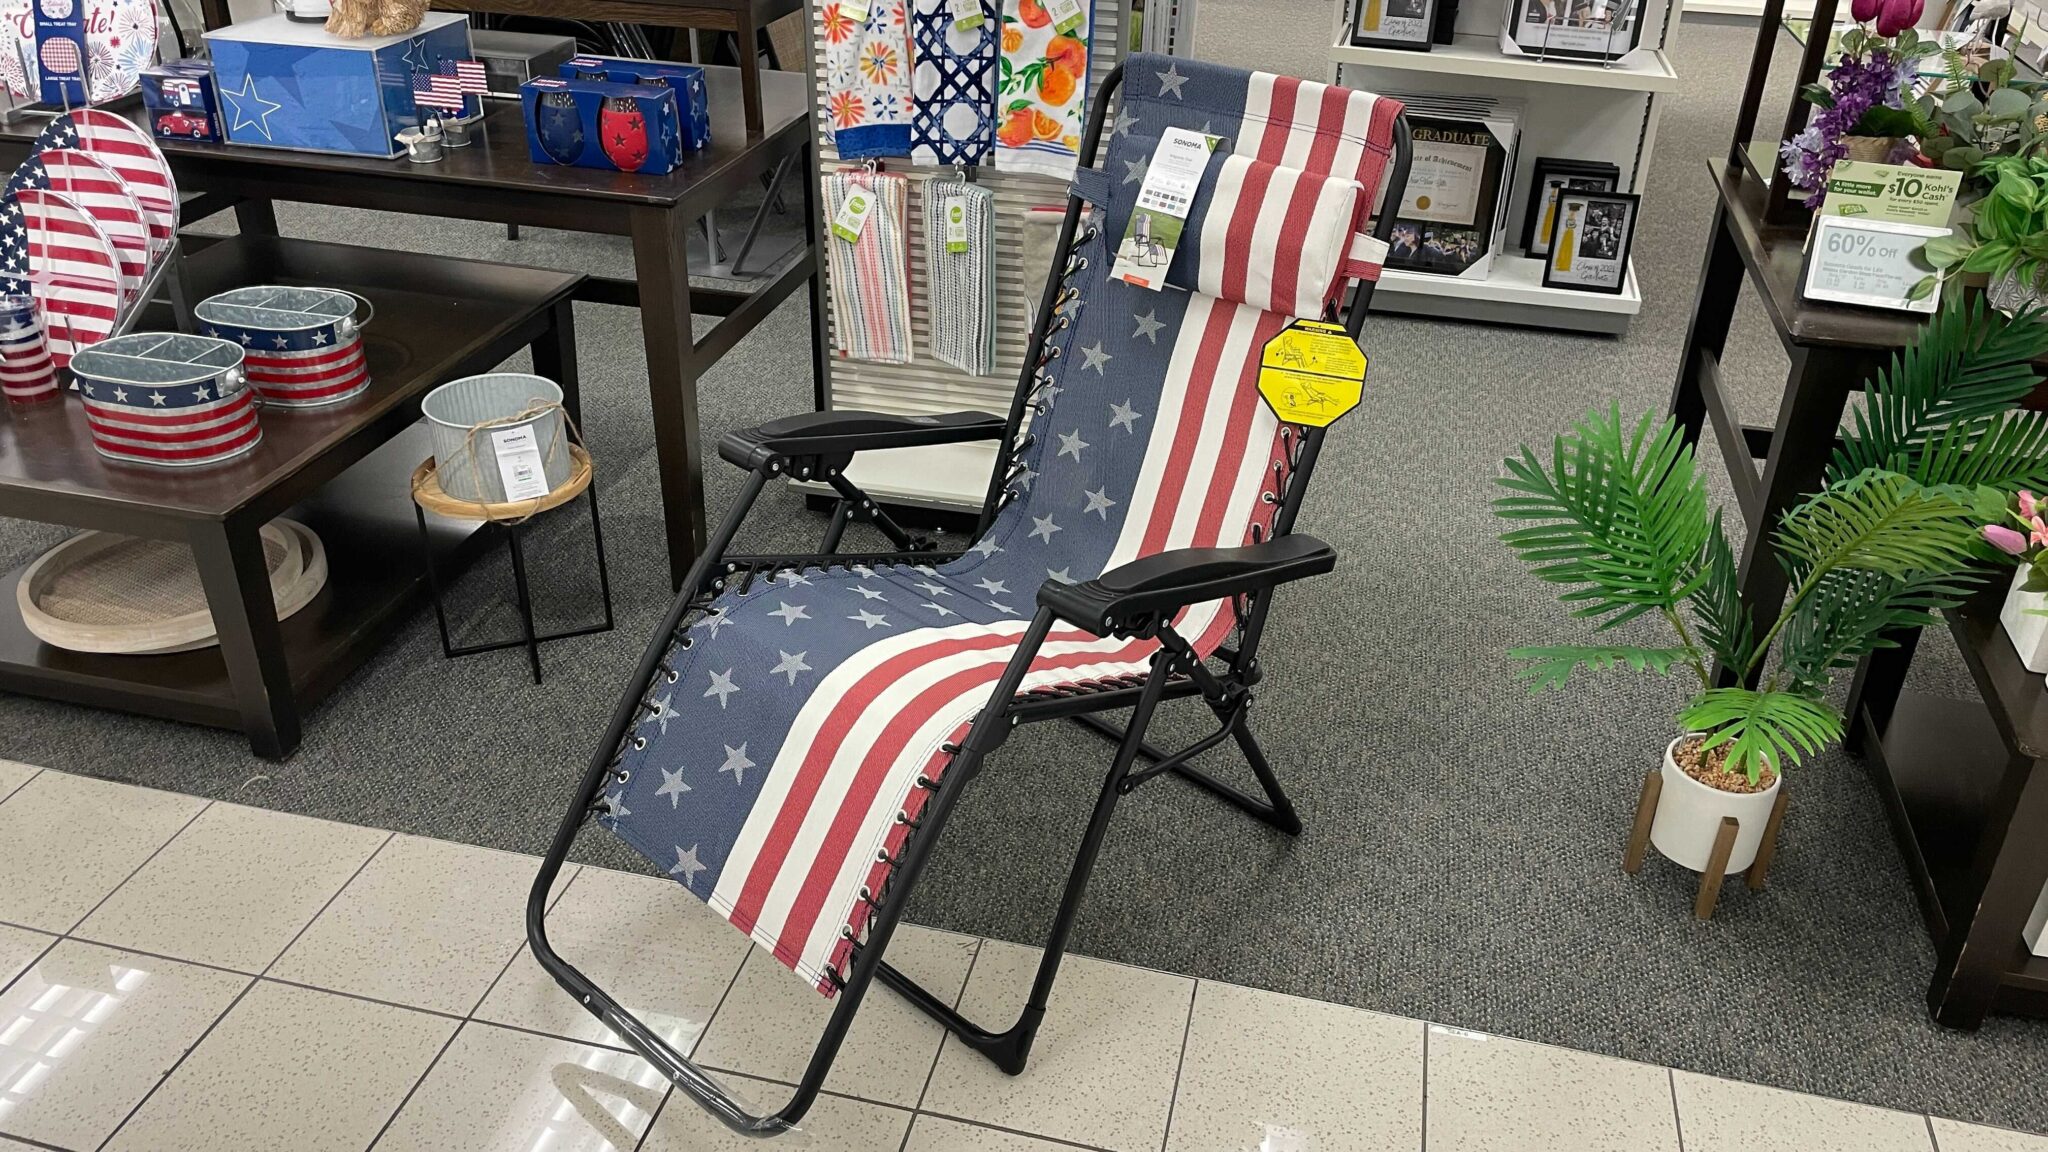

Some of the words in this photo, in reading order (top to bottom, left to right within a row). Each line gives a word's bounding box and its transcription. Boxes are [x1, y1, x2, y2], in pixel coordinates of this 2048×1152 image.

[1173, 138, 1202, 150] SONOMA
[1412, 128, 1490, 146] GRADUATE
[1888, 177, 1923, 198] $10
[1924, 183, 1953, 193] Kohl's
[1827, 232, 1876, 258] 60%
[1878, 247, 1899, 259] Off
[503, 435, 527, 443] SONOMA
